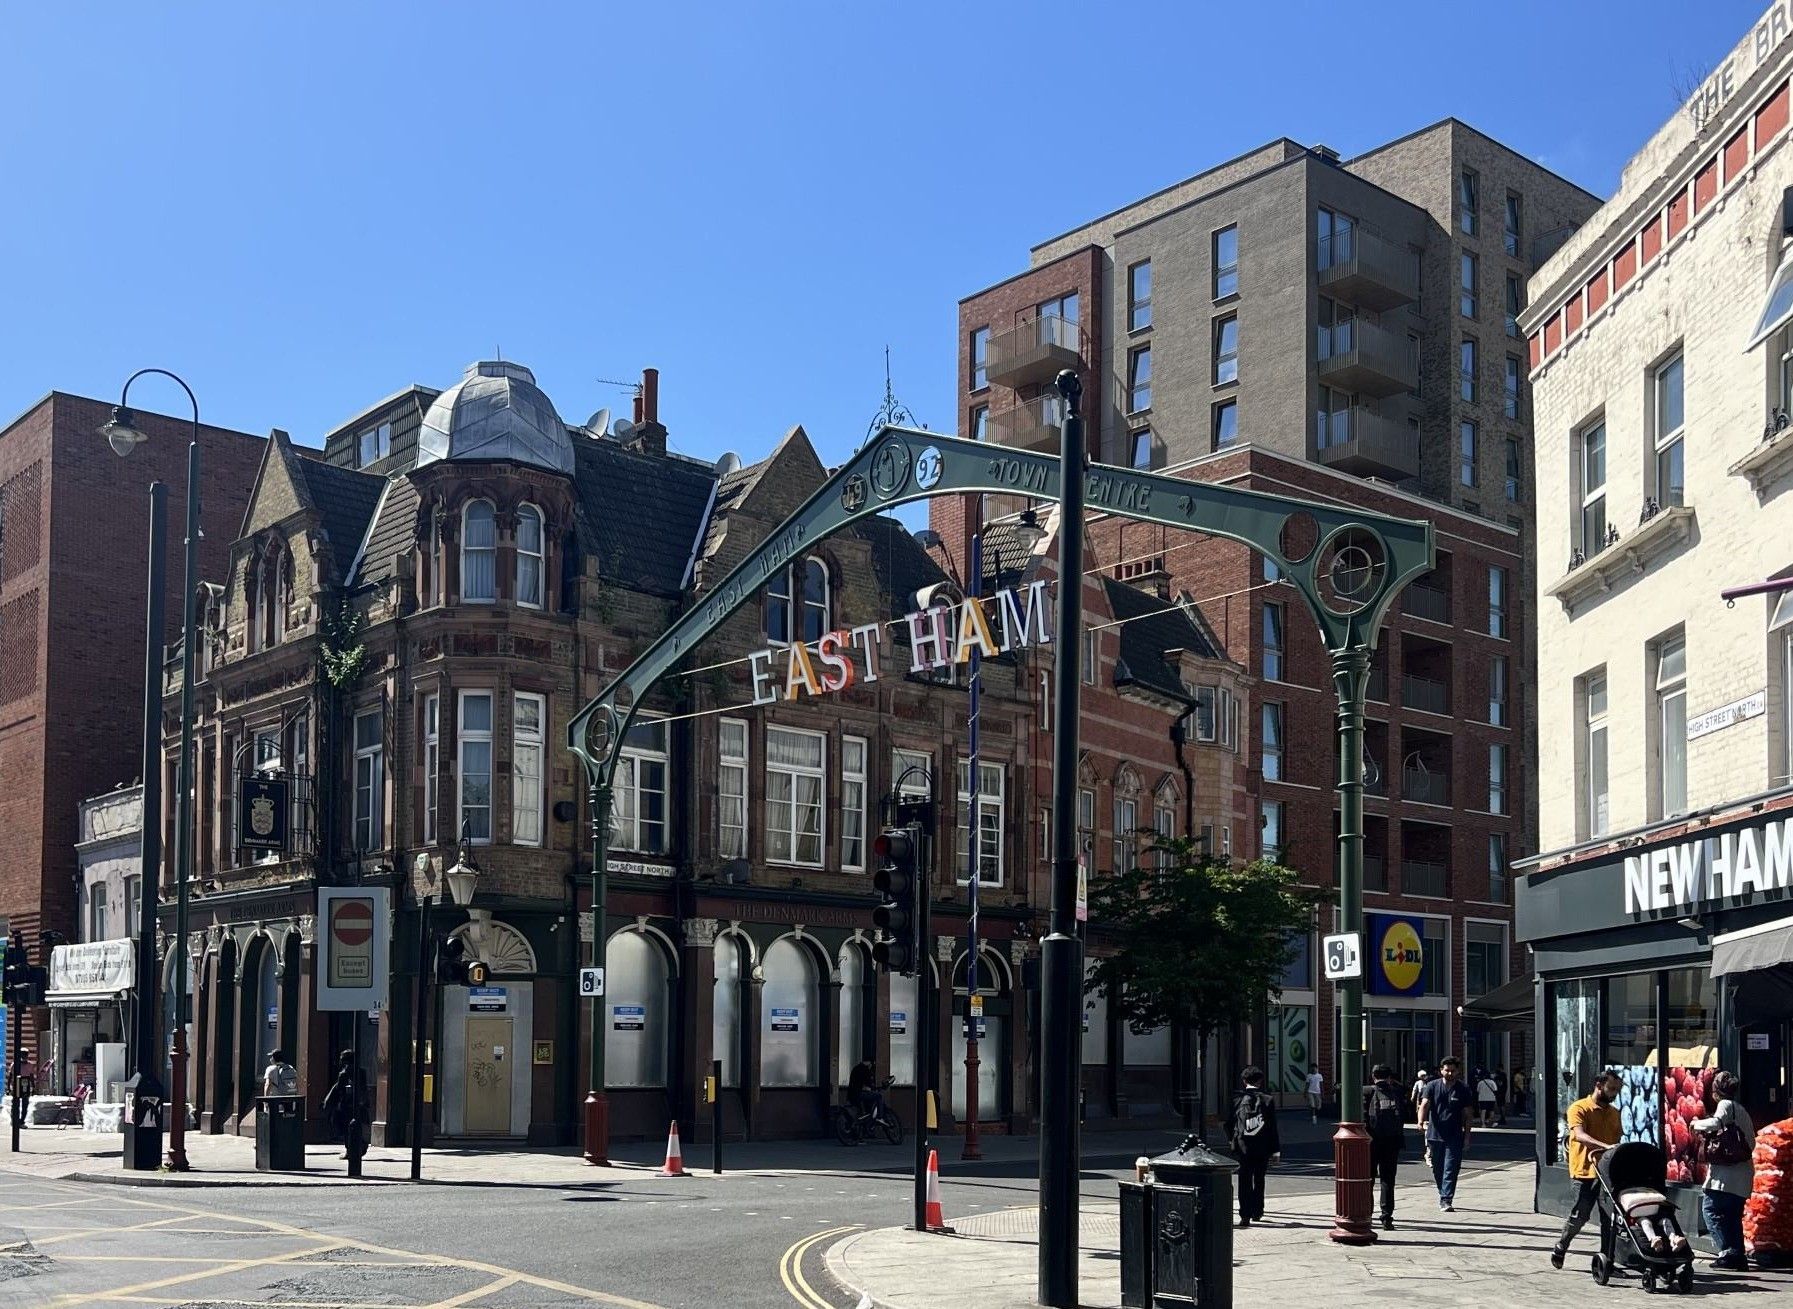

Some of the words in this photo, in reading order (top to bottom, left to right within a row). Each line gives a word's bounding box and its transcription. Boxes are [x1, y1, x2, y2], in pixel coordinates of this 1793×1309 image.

[1690, 60, 1735, 131] THE
[1755, 0, 1793, 67] BR
[999, 458, 1049, 493] TOWN
[1086, 474, 1152, 512] ENTRE
[706, 576, 744, 625] EAST
[748, 622, 885, 706] EAST
[904, 579, 1052, 673] HAM
[1688, 720, 1704, 735] HIGH
[1705, 708, 1731, 730] STREET
[1732, 699, 1757, 719] NORTH
[646, 867, 669, 876] NORTH
[735, 903, 760, 918] THE
[764, 903, 825, 921] DENMARK
